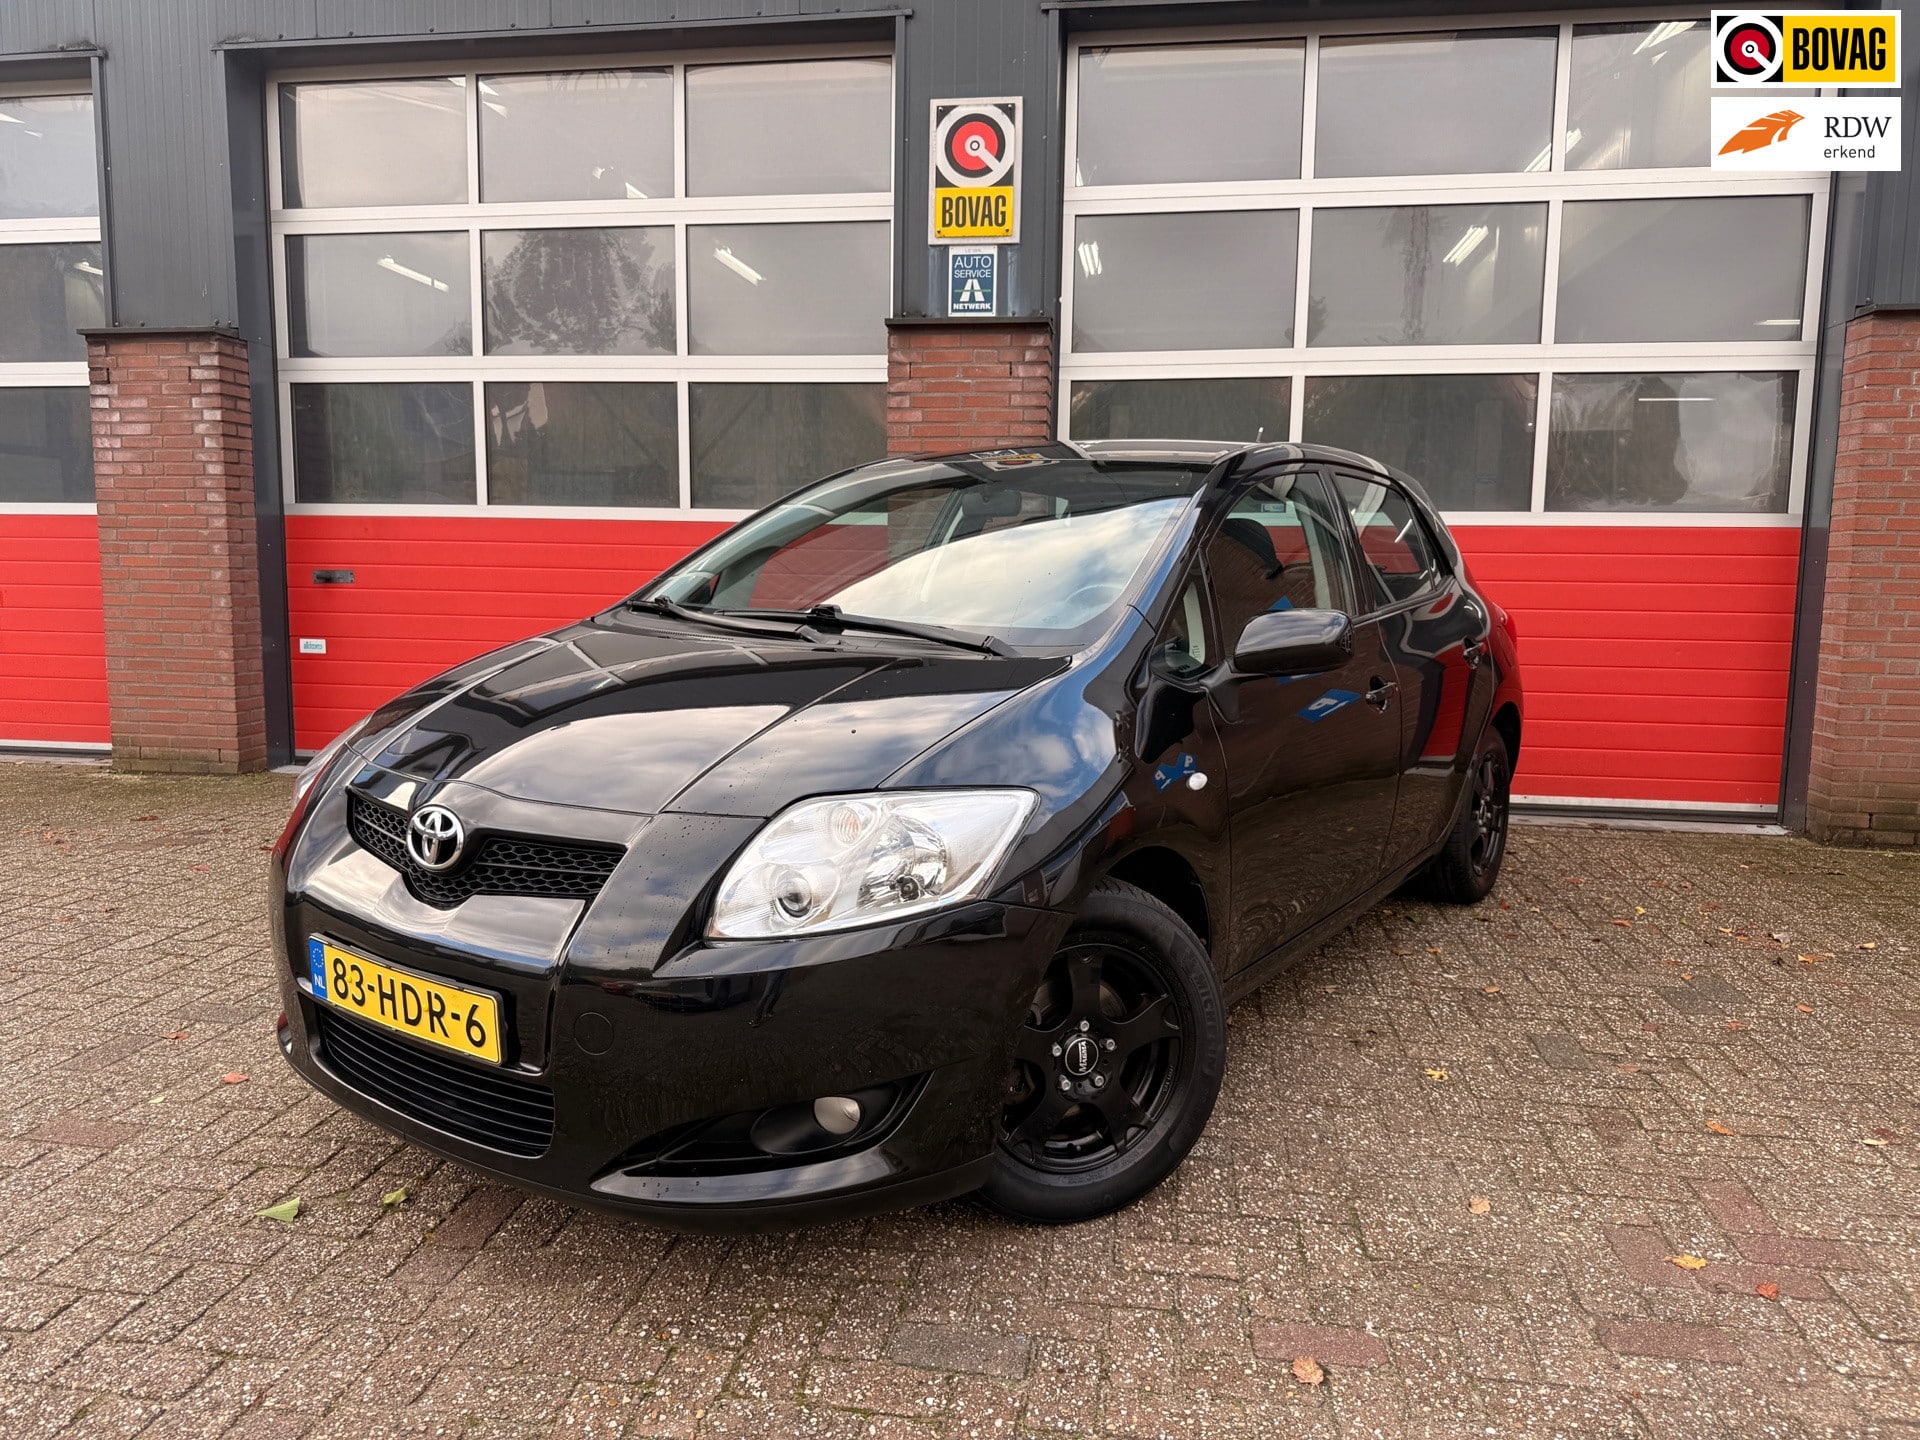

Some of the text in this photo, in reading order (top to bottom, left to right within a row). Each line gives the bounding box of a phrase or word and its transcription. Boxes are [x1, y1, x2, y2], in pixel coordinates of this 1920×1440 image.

[942, 195, 1007, 228] BOVAG
[954, 255, 992, 269] AUTO
[954, 269, 992, 279] SERVICE
[953, 302, 991, 310] NETWERK
[314, 973, 326, 990] NL
[333, 957, 487, 1048] 83-HDR-6
[1191, 970, 1218, 1075] MICHIN
